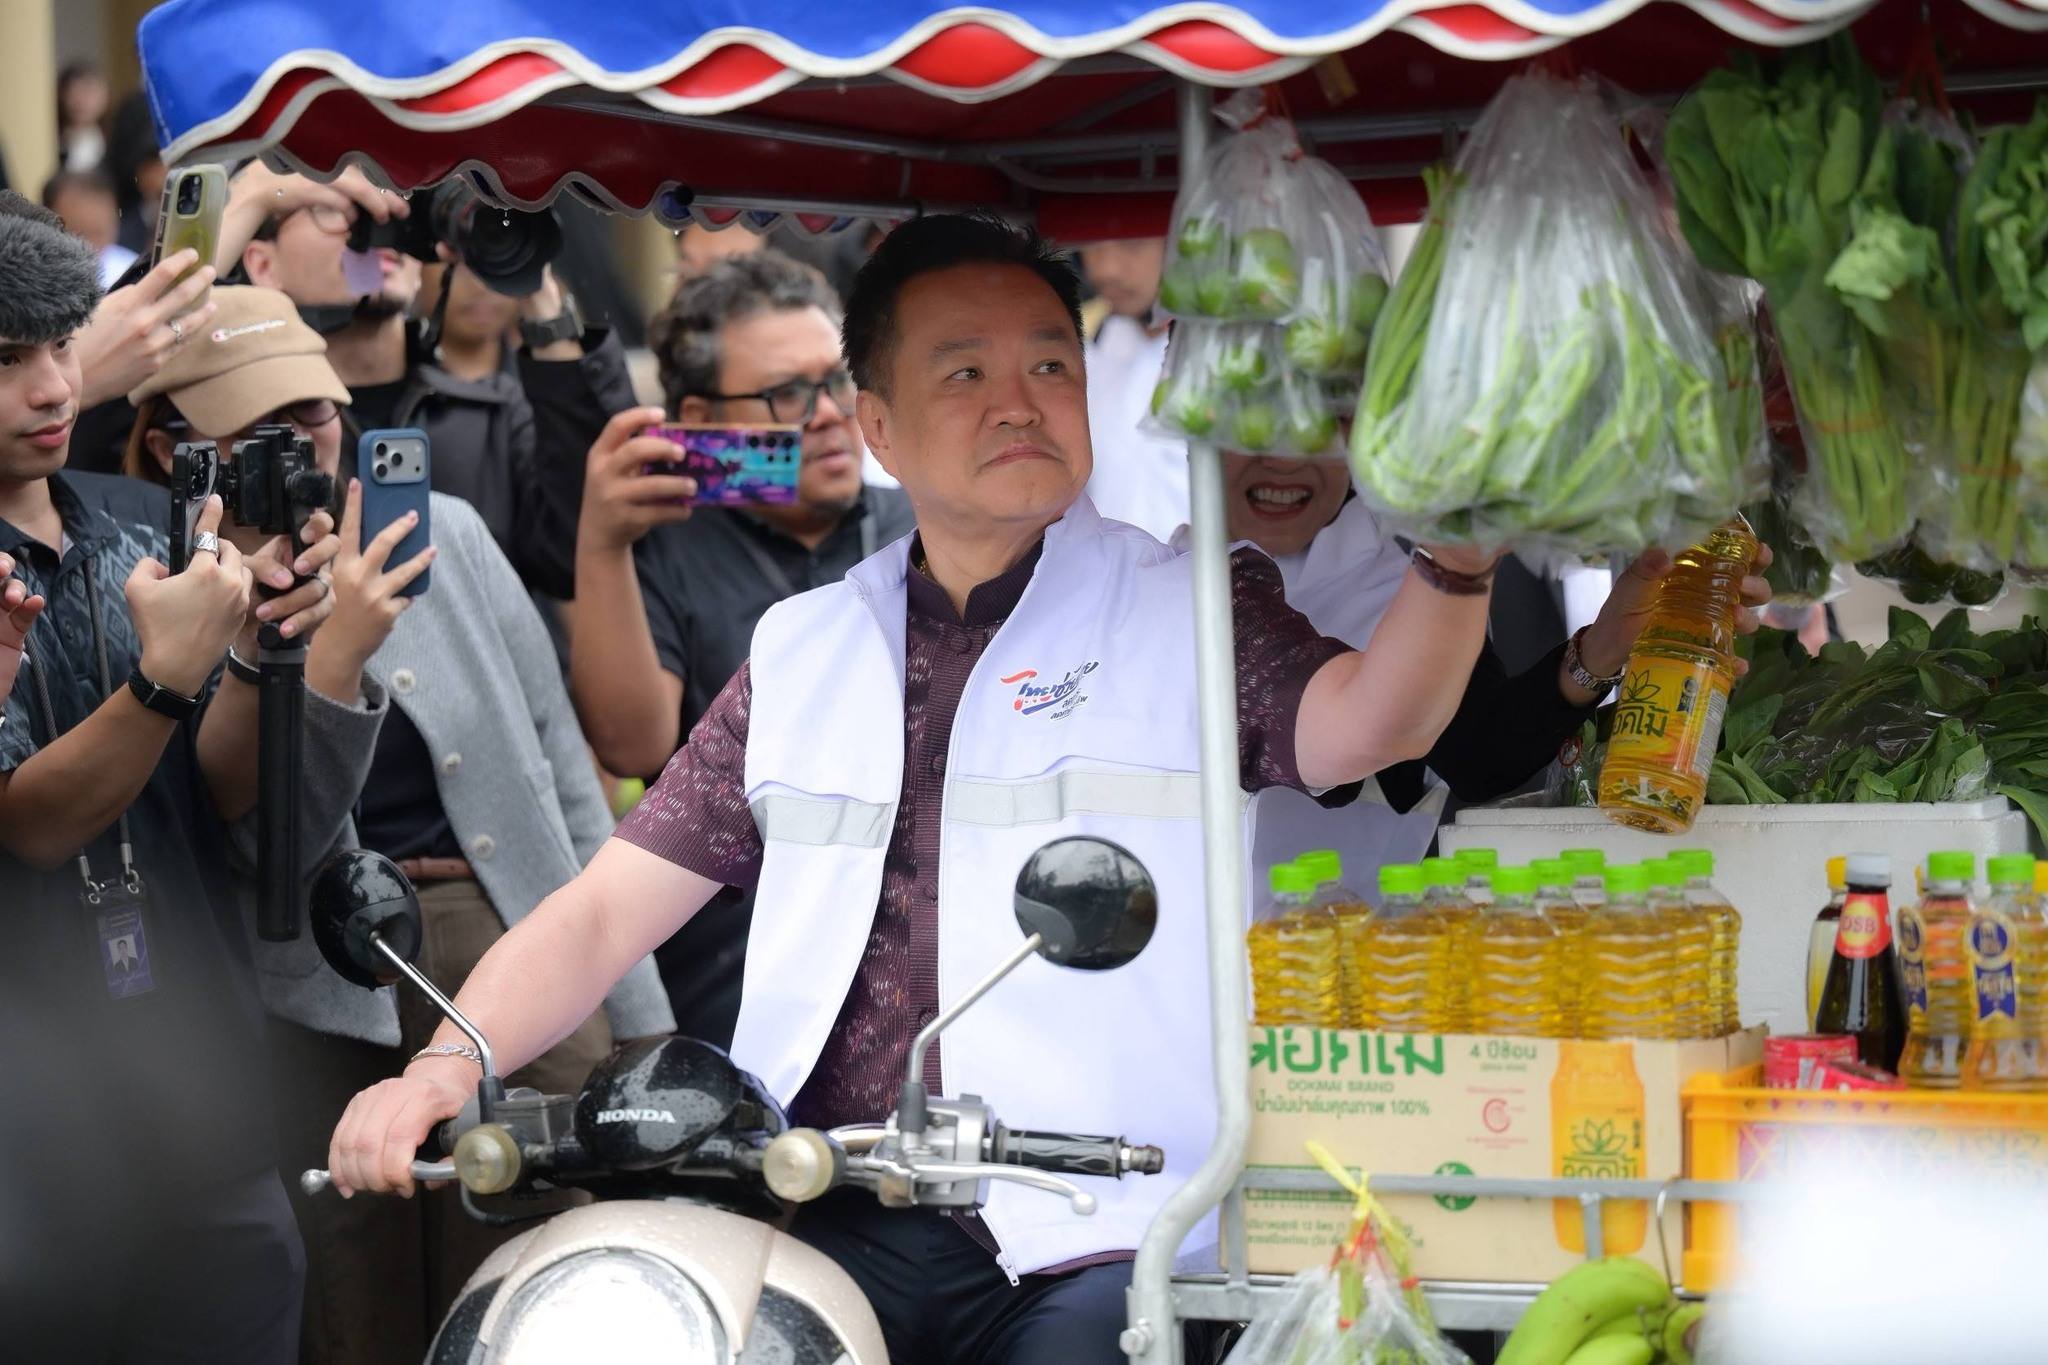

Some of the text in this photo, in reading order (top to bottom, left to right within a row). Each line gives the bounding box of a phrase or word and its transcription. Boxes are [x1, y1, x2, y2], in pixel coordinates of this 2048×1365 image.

[1612, 704, 1670, 739] อกไม้
[1287, 1079, 1394, 1093] DOKMAI BRAND
[1391, 1099, 1430, 1116] 100%
[596, 1108, 677, 1124] HONDA
